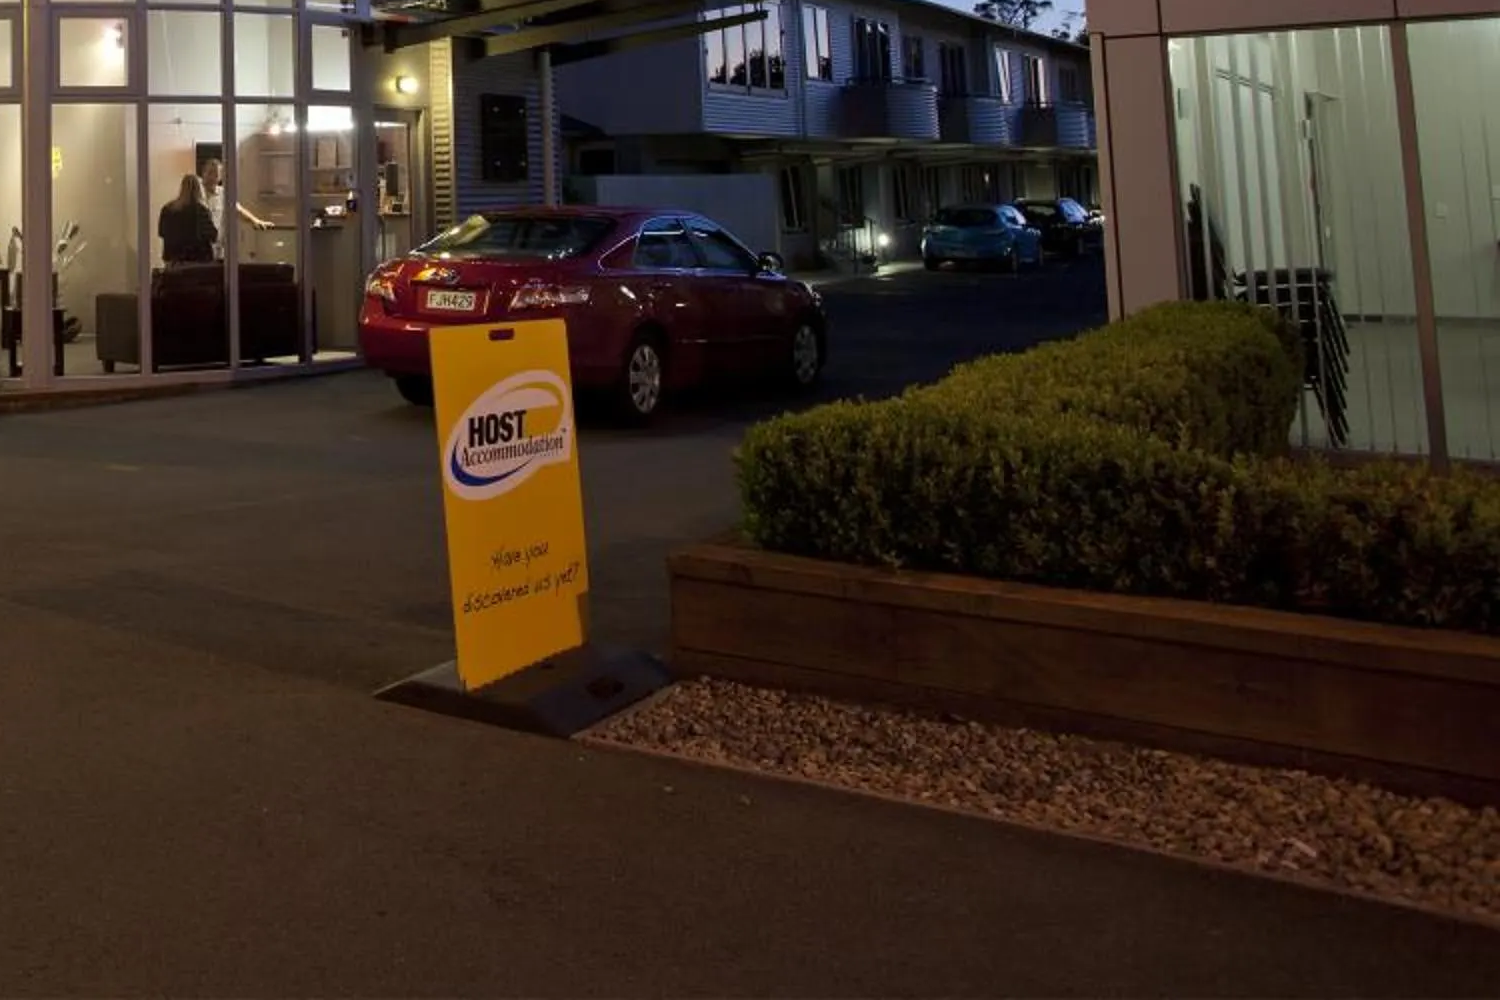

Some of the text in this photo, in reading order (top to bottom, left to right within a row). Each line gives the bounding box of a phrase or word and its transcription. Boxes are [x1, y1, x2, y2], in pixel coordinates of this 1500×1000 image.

[468, 410, 527, 449] HOST
[462, 433, 563, 467] Accommodation
[490, 541, 549, 570] Have you
[534, 573, 551, 594] us
